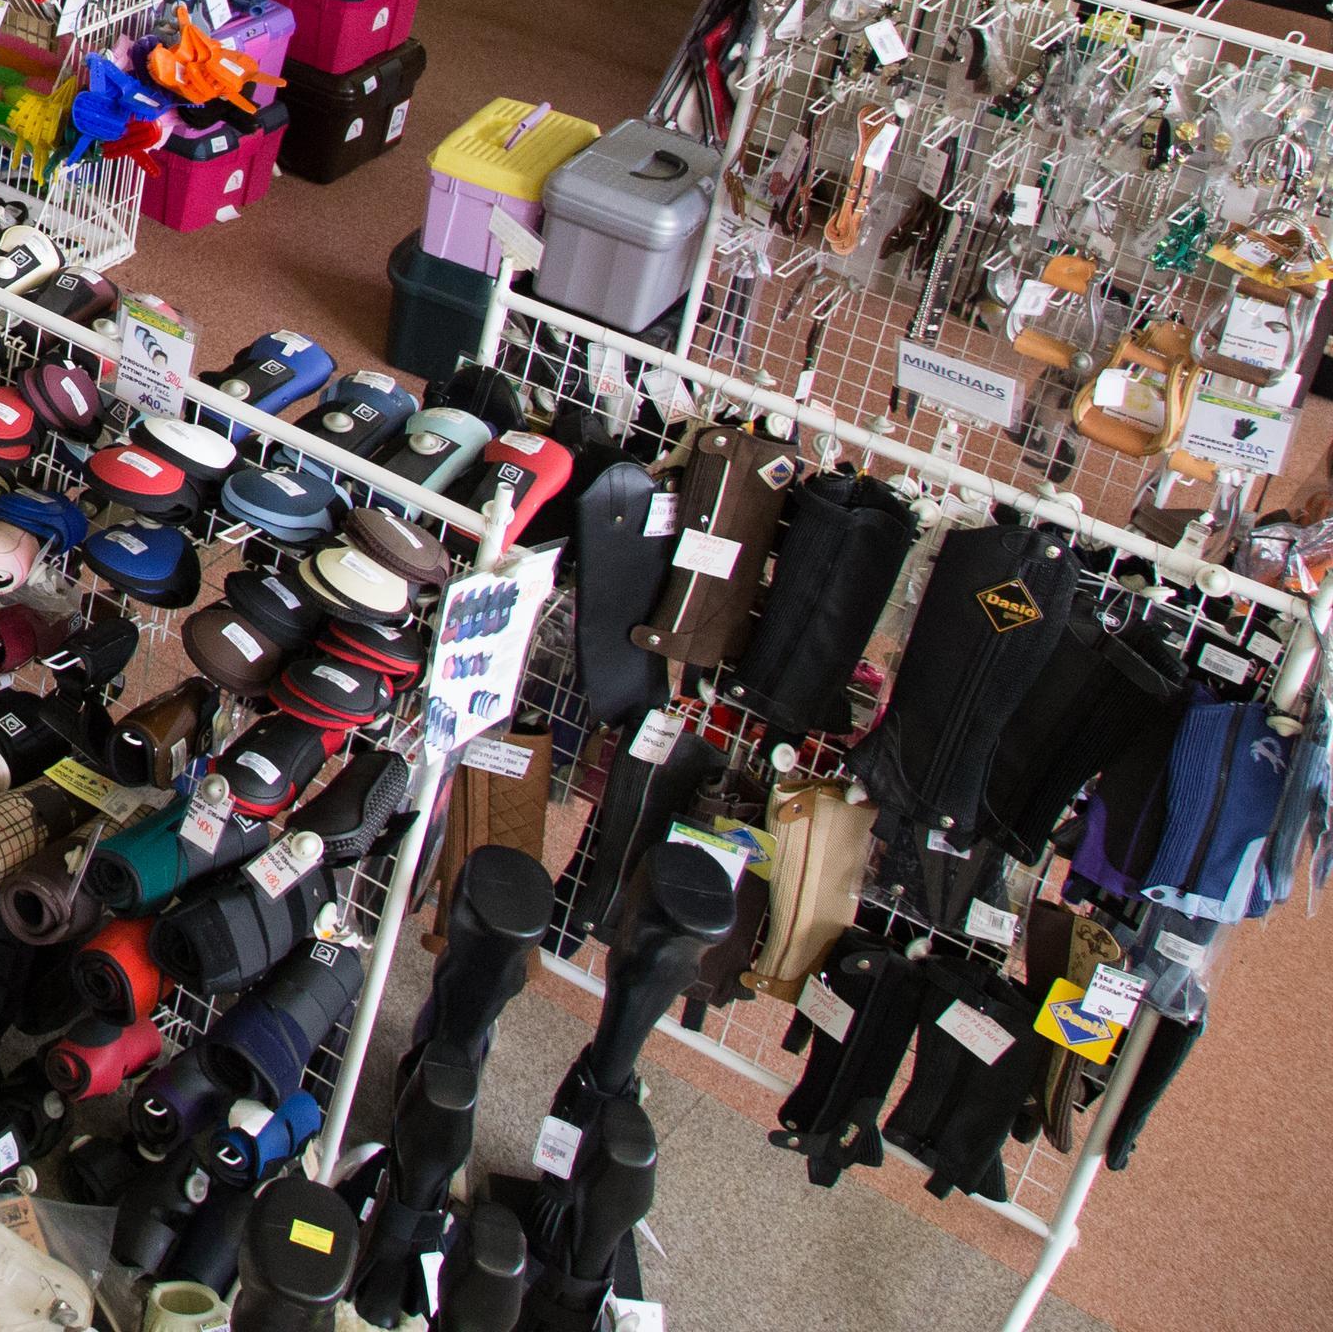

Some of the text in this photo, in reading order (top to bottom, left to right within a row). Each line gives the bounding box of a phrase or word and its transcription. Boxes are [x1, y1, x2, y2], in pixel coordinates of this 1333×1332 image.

[118, 361, 143, 379] TATTINI
[120, 354, 161, 377] STROUHAVKY
[902, 352, 1008, 401] MINICHAPS
[1234, 451, 1270, 465] TATTINI
